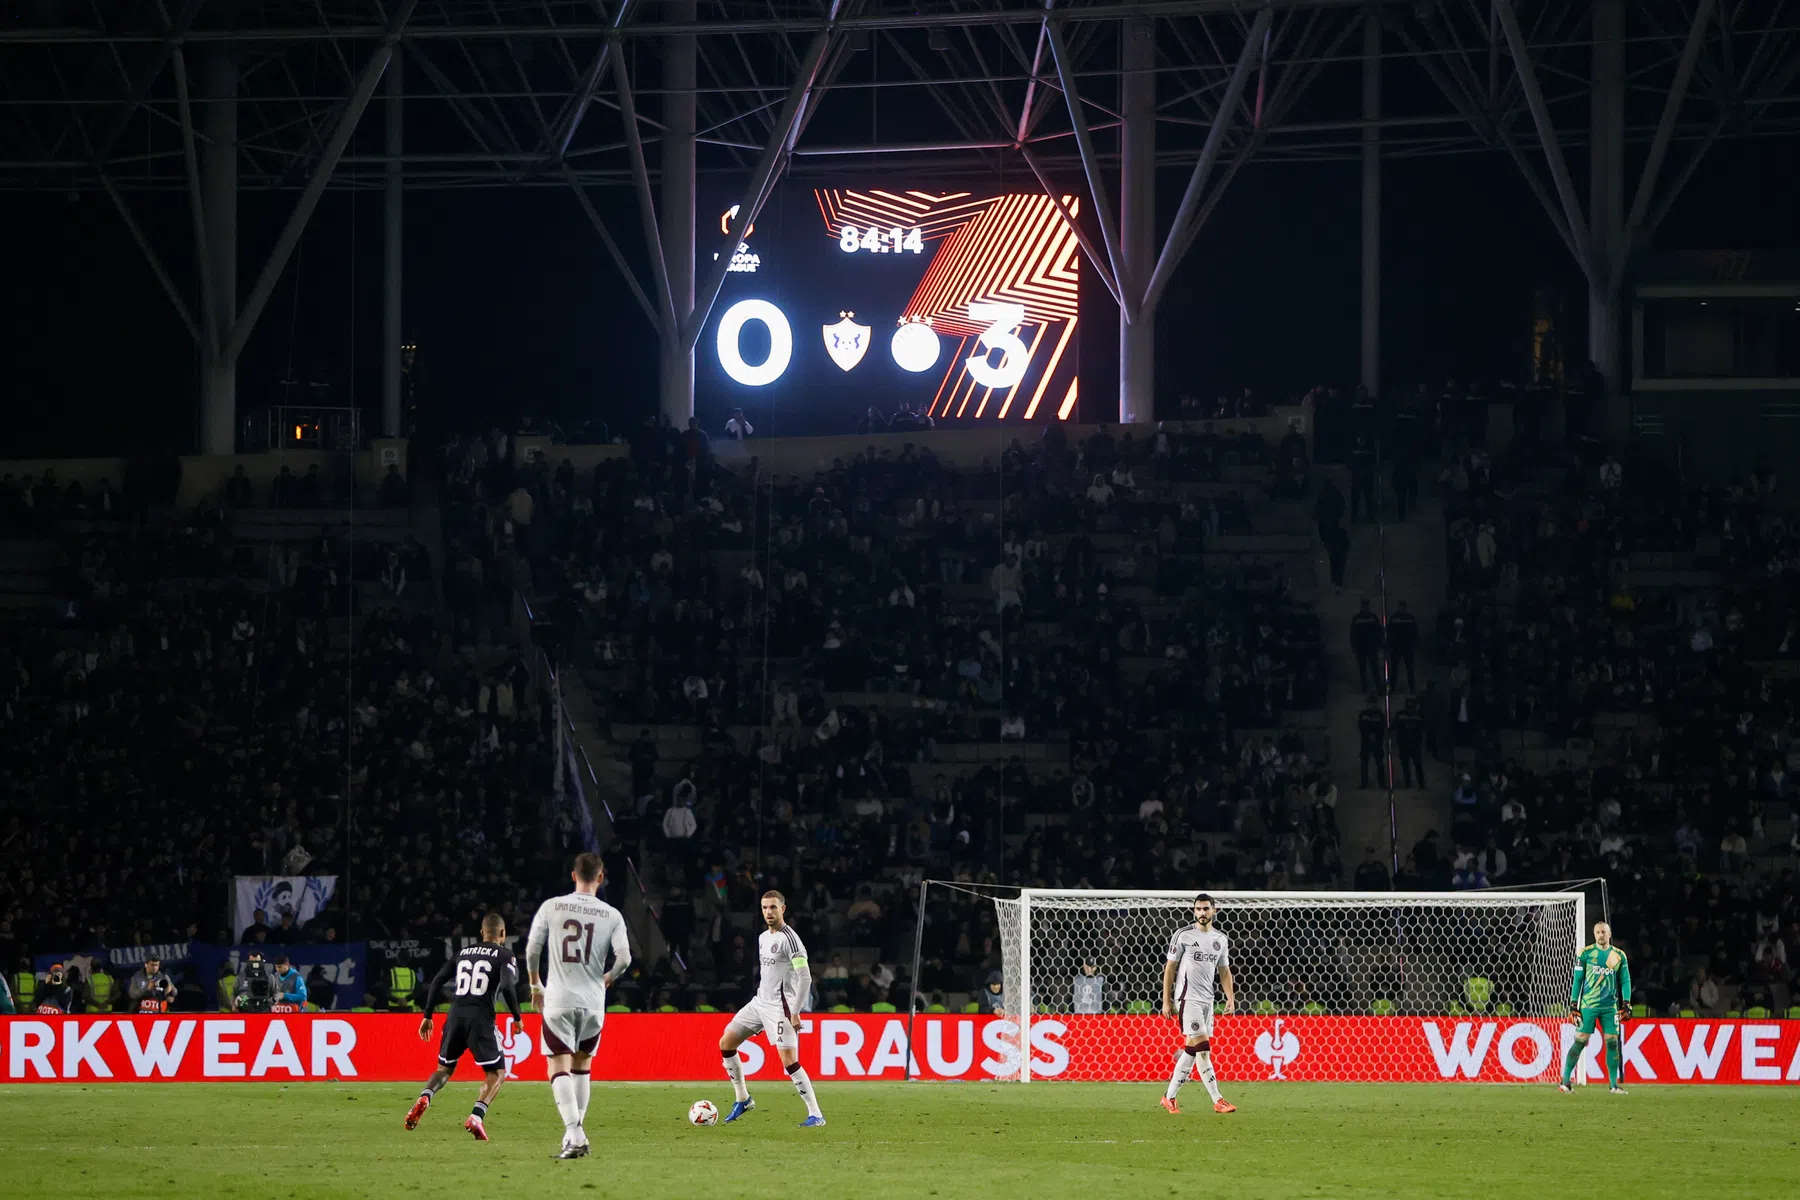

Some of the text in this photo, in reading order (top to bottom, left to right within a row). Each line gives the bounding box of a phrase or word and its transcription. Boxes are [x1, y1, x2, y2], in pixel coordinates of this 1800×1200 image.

[839, 226, 924, 254] 84:14
[717, 299, 792, 386] 0
[965, 303, 1028, 388] 3
[555, 902, 610, 918] VAN DEN BOOMEN
[459, 946, 492, 956] PATRICK
[562, 918, 594, 966] 21
[455, 959, 492, 996] 66
[0, 1018, 359, 1077] RKWEAR
[776, 1021, 784, 1035] 6
[1422, 1021, 1800, 1081] WORKWE
